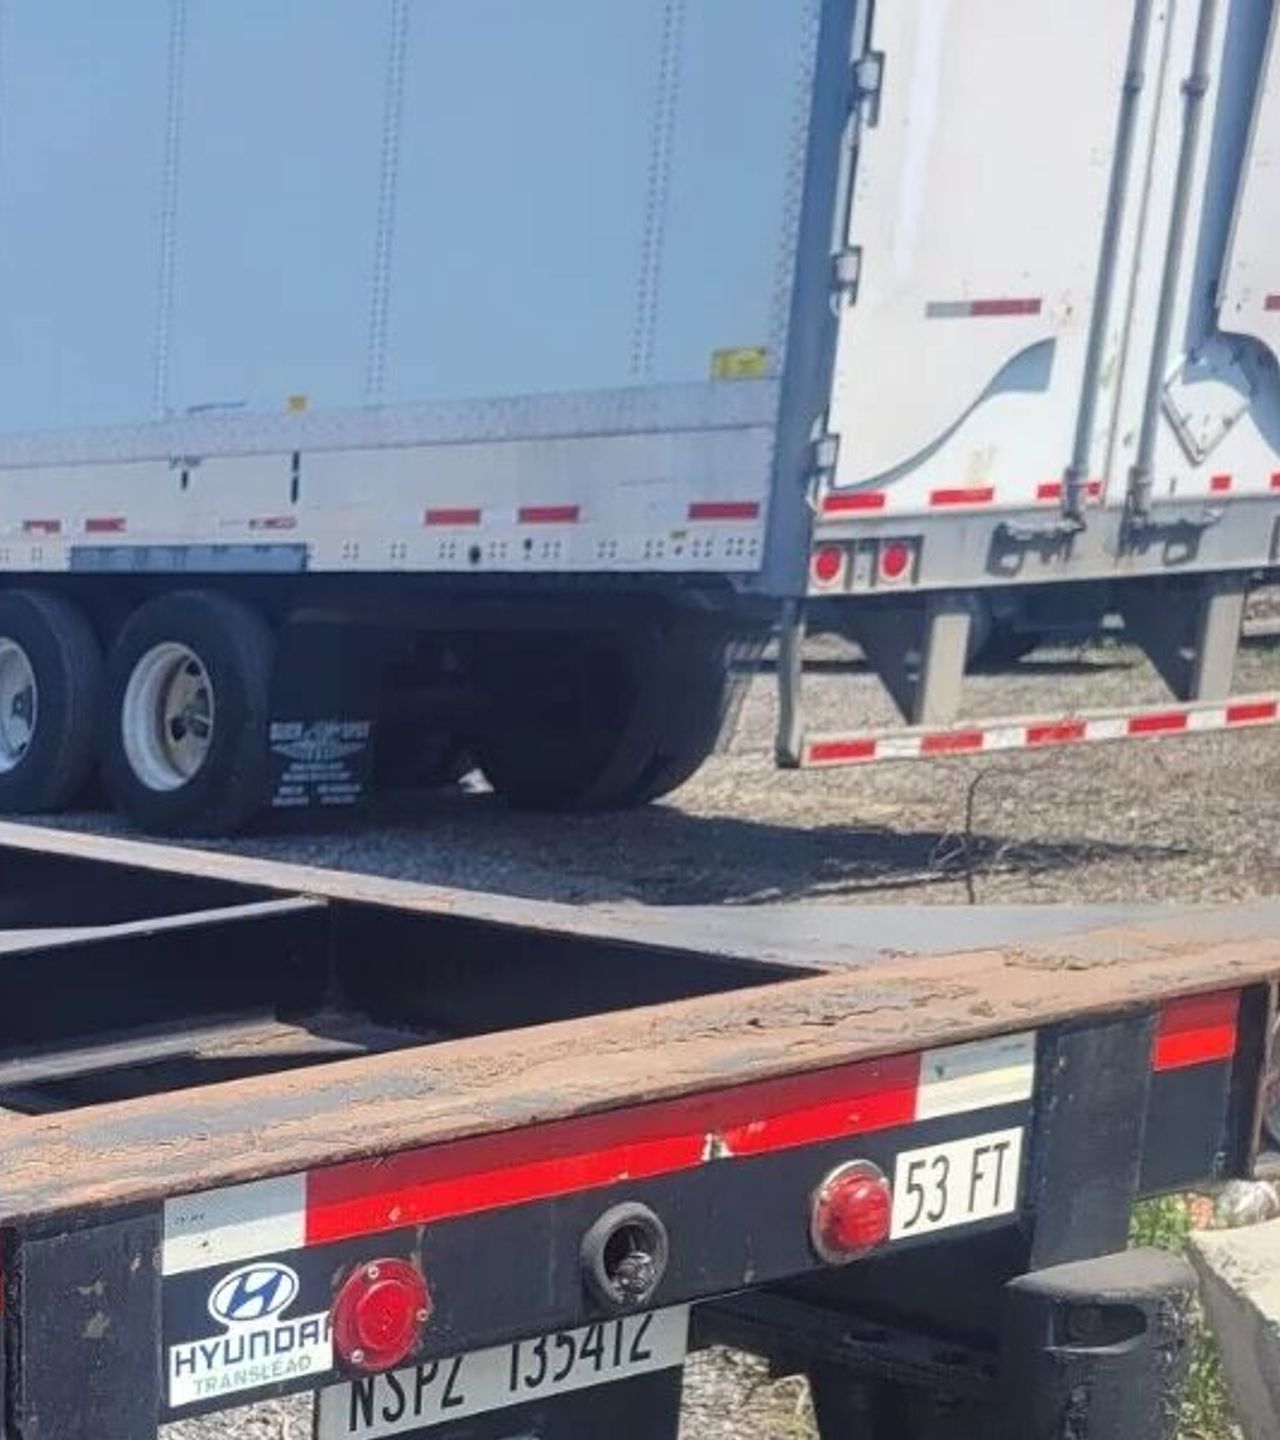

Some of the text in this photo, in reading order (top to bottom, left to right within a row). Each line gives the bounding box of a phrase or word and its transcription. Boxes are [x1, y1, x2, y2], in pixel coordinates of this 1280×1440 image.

[903, 1140, 1011, 1229] 53 FT
[175, 1314, 329, 1378] HYUNDAI
[193, 1355, 312, 1395] TRANSLEAD
